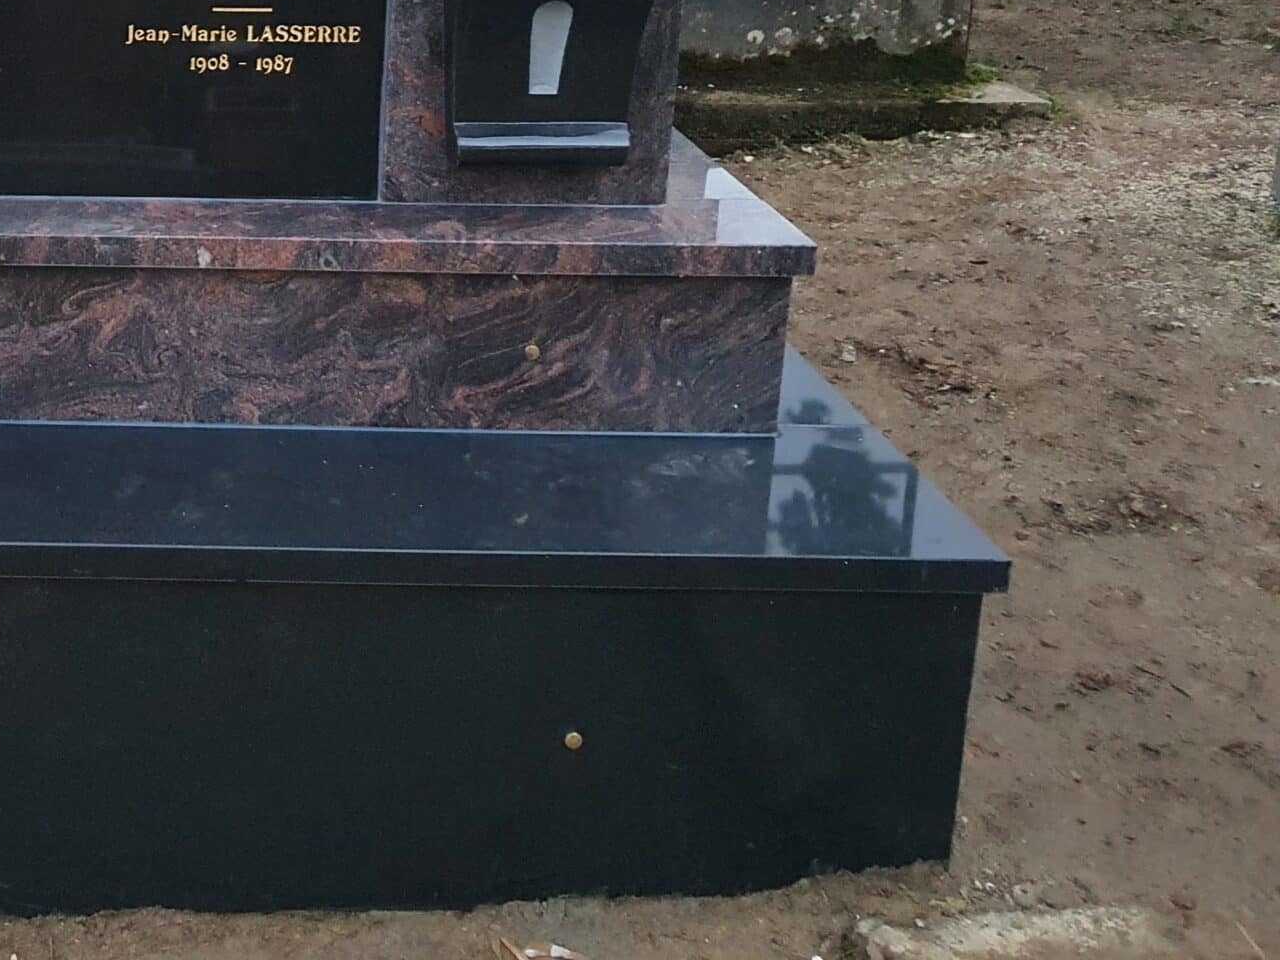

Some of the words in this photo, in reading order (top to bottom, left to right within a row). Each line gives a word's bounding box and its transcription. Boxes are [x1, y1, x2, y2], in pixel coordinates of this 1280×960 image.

[126, 24, 238, 44] Jean-Marie
[246, 25, 361, 43] LASSERRE
[189, 54, 230, 74] 1908
[255, 55, 294, 74] 1987
